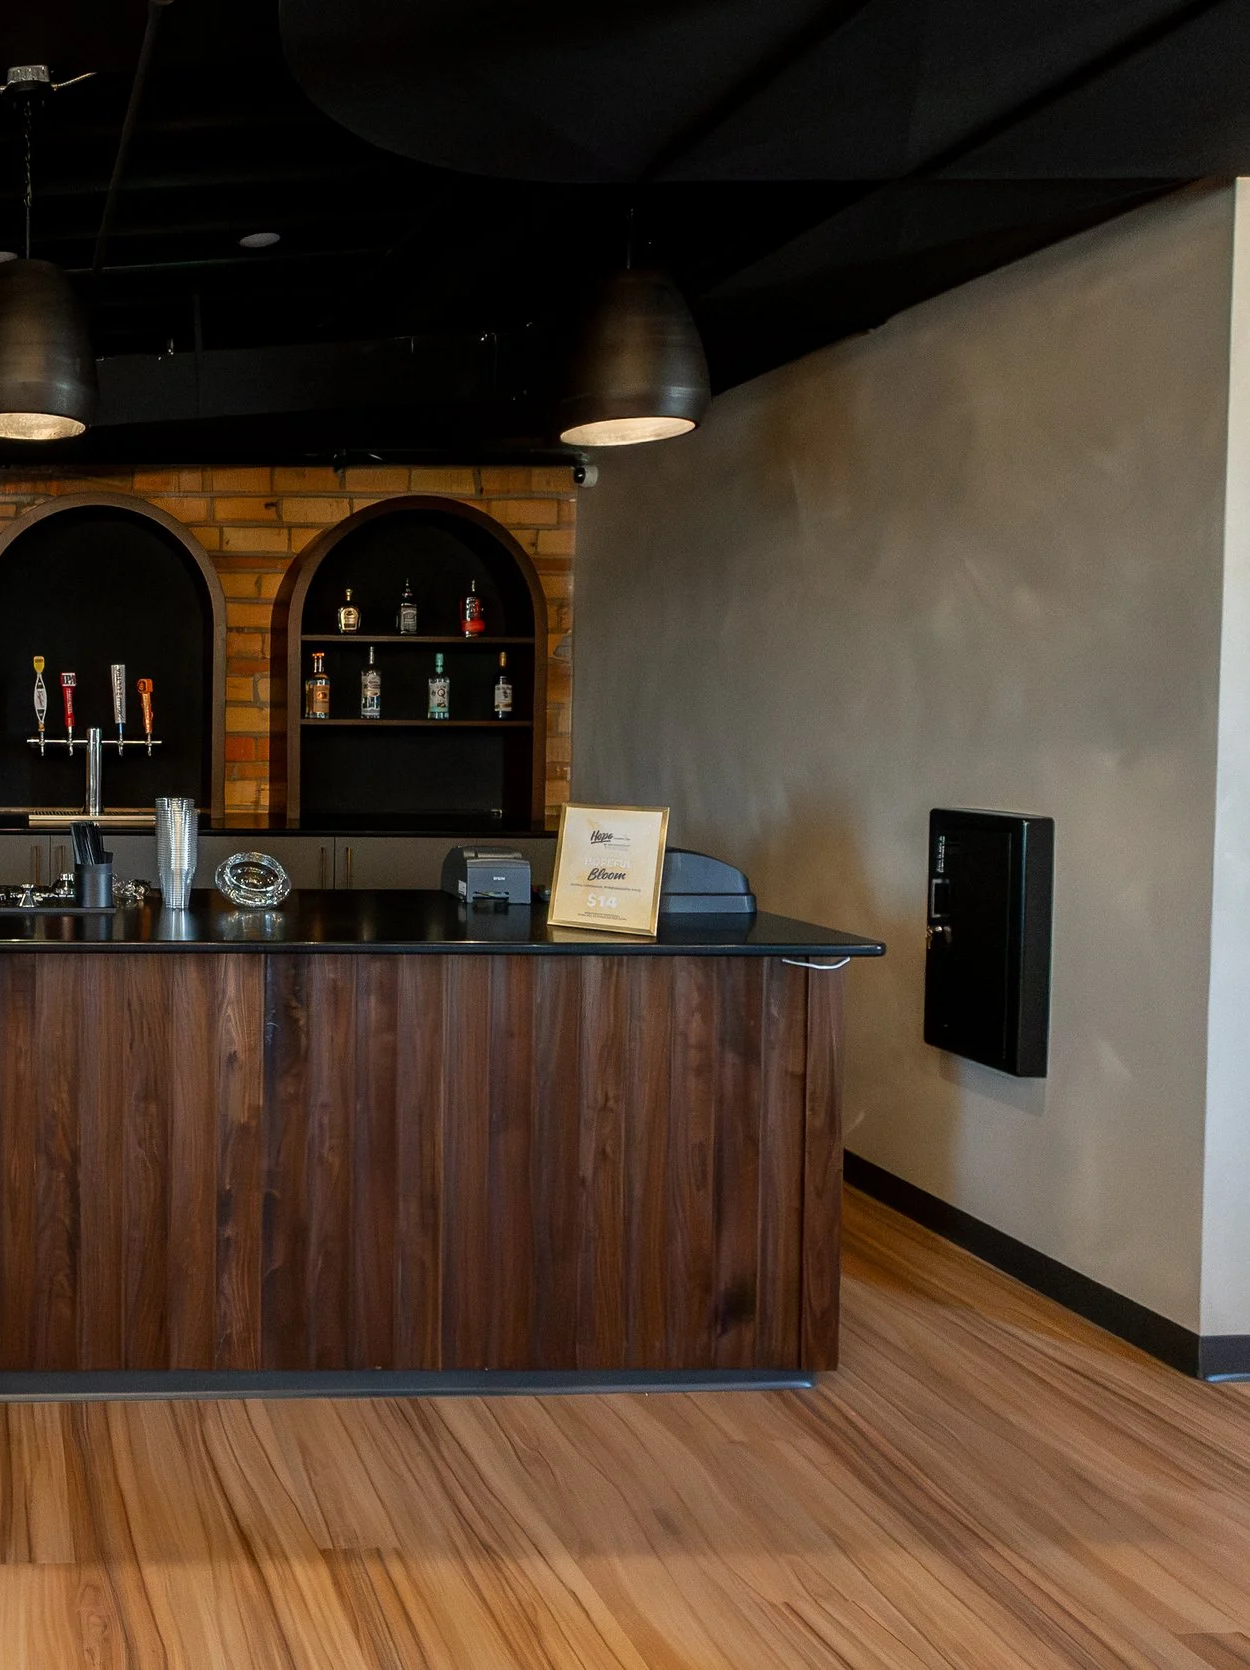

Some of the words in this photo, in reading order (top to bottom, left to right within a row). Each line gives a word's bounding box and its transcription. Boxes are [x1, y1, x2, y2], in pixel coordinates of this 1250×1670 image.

[590, 830, 613, 843] Hope
[588, 868, 626, 881] Bloom
[587, 893, 618, 909] $14
